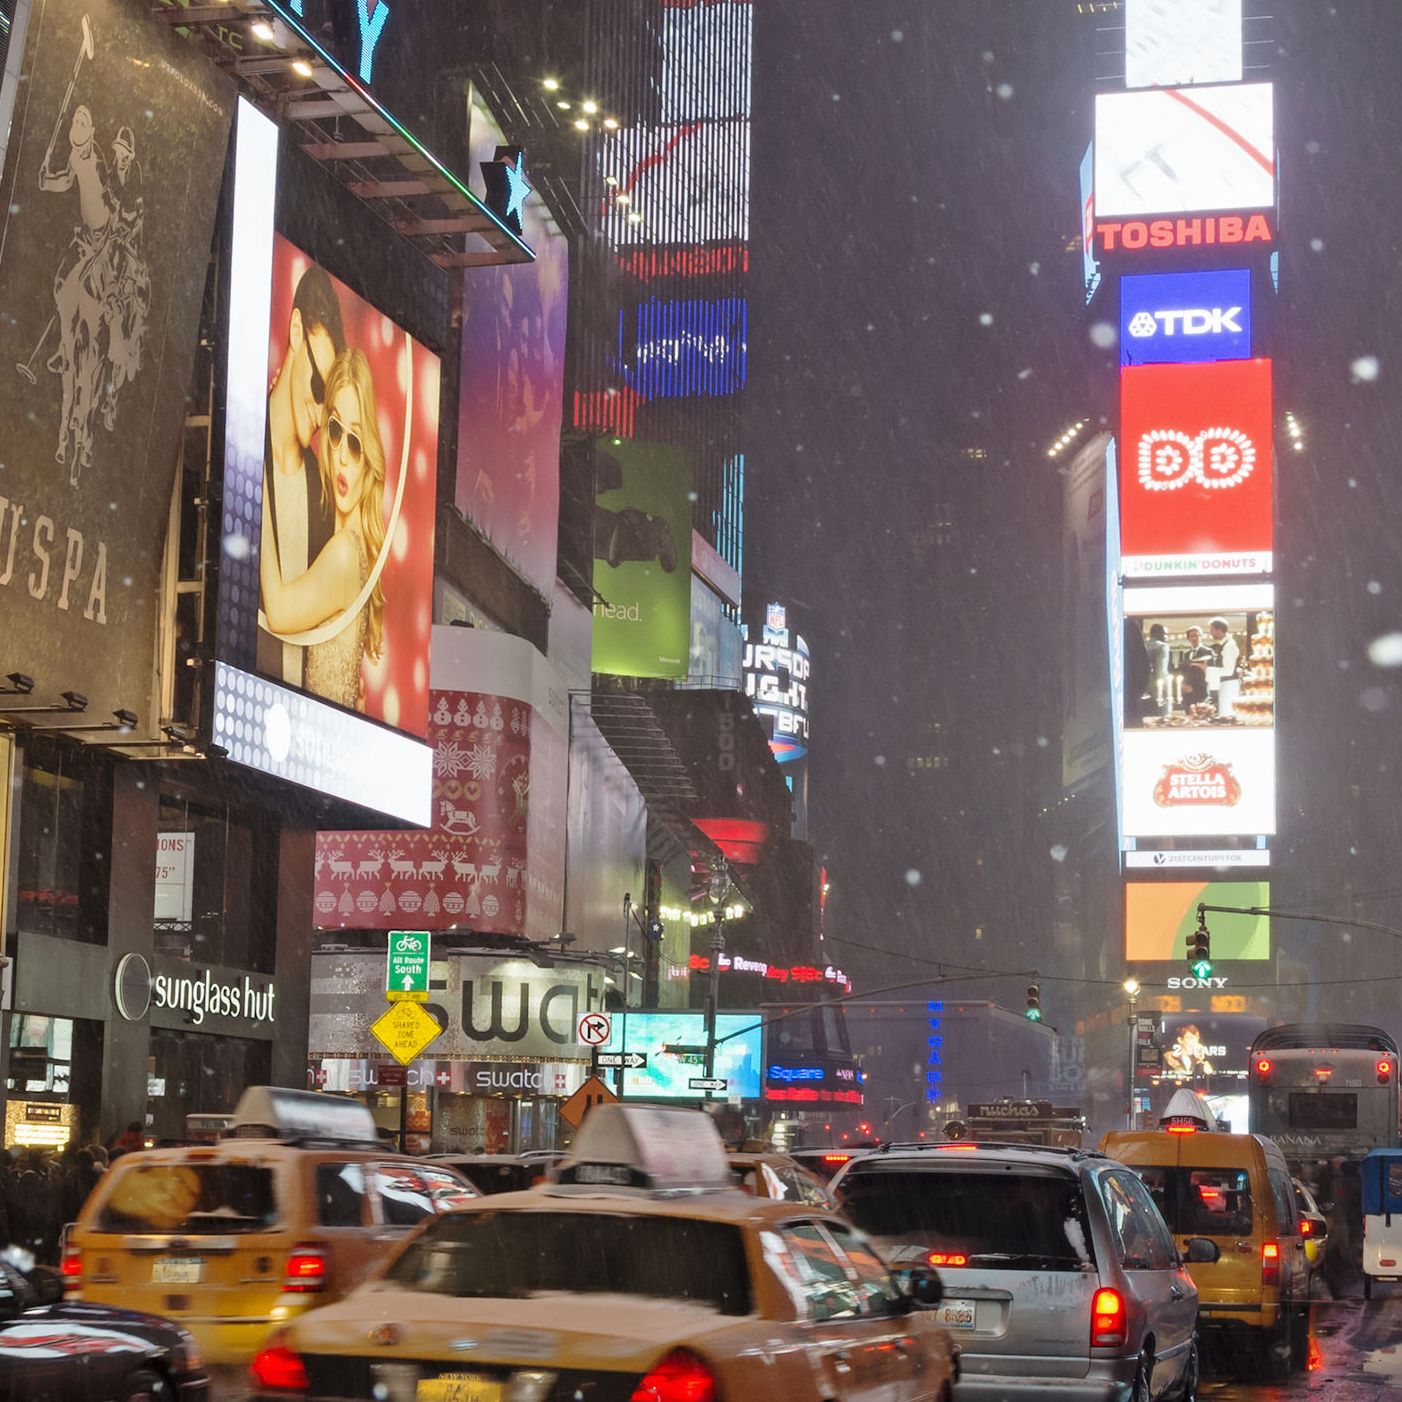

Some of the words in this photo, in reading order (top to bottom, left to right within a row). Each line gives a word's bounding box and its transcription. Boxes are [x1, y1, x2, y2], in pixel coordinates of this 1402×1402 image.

[1097, 213, 1273, 251] TOSHIBA
[1161, 305, 1244, 335] TDK
[1137, 426, 1257, 493] DD
[1201, 557, 1257, 571] DONUTS
[769, 612, 783, 628] NFL
[1170, 773, 1226, 786] STELLA
[1167, 785, 1228, 800] ARTOIS
[1187, 855, 1226, 863] CENTURY
[394, 965, 423, 975] South
[1166, 977, 1229, 989] SONY
[154, 968, 241, 1025] sunglass
[244, 976, 276, 1023] hut
[392, 1021, 421, 1030] SHARED
[397, 1031, 415, 1039] ZONE
[393, 1040, 418, 1048] AHEAD
[601, 1055, 618, 1065] ONE
[623, 1055, 640, 1065] WAY
[349, 1066, 436, 1086] swch
[768, 1065, 825, 1083] Square
[979, 1104, 1040, 1118] nuchas
[1269, 1134, 1322, 1146] BANANA
